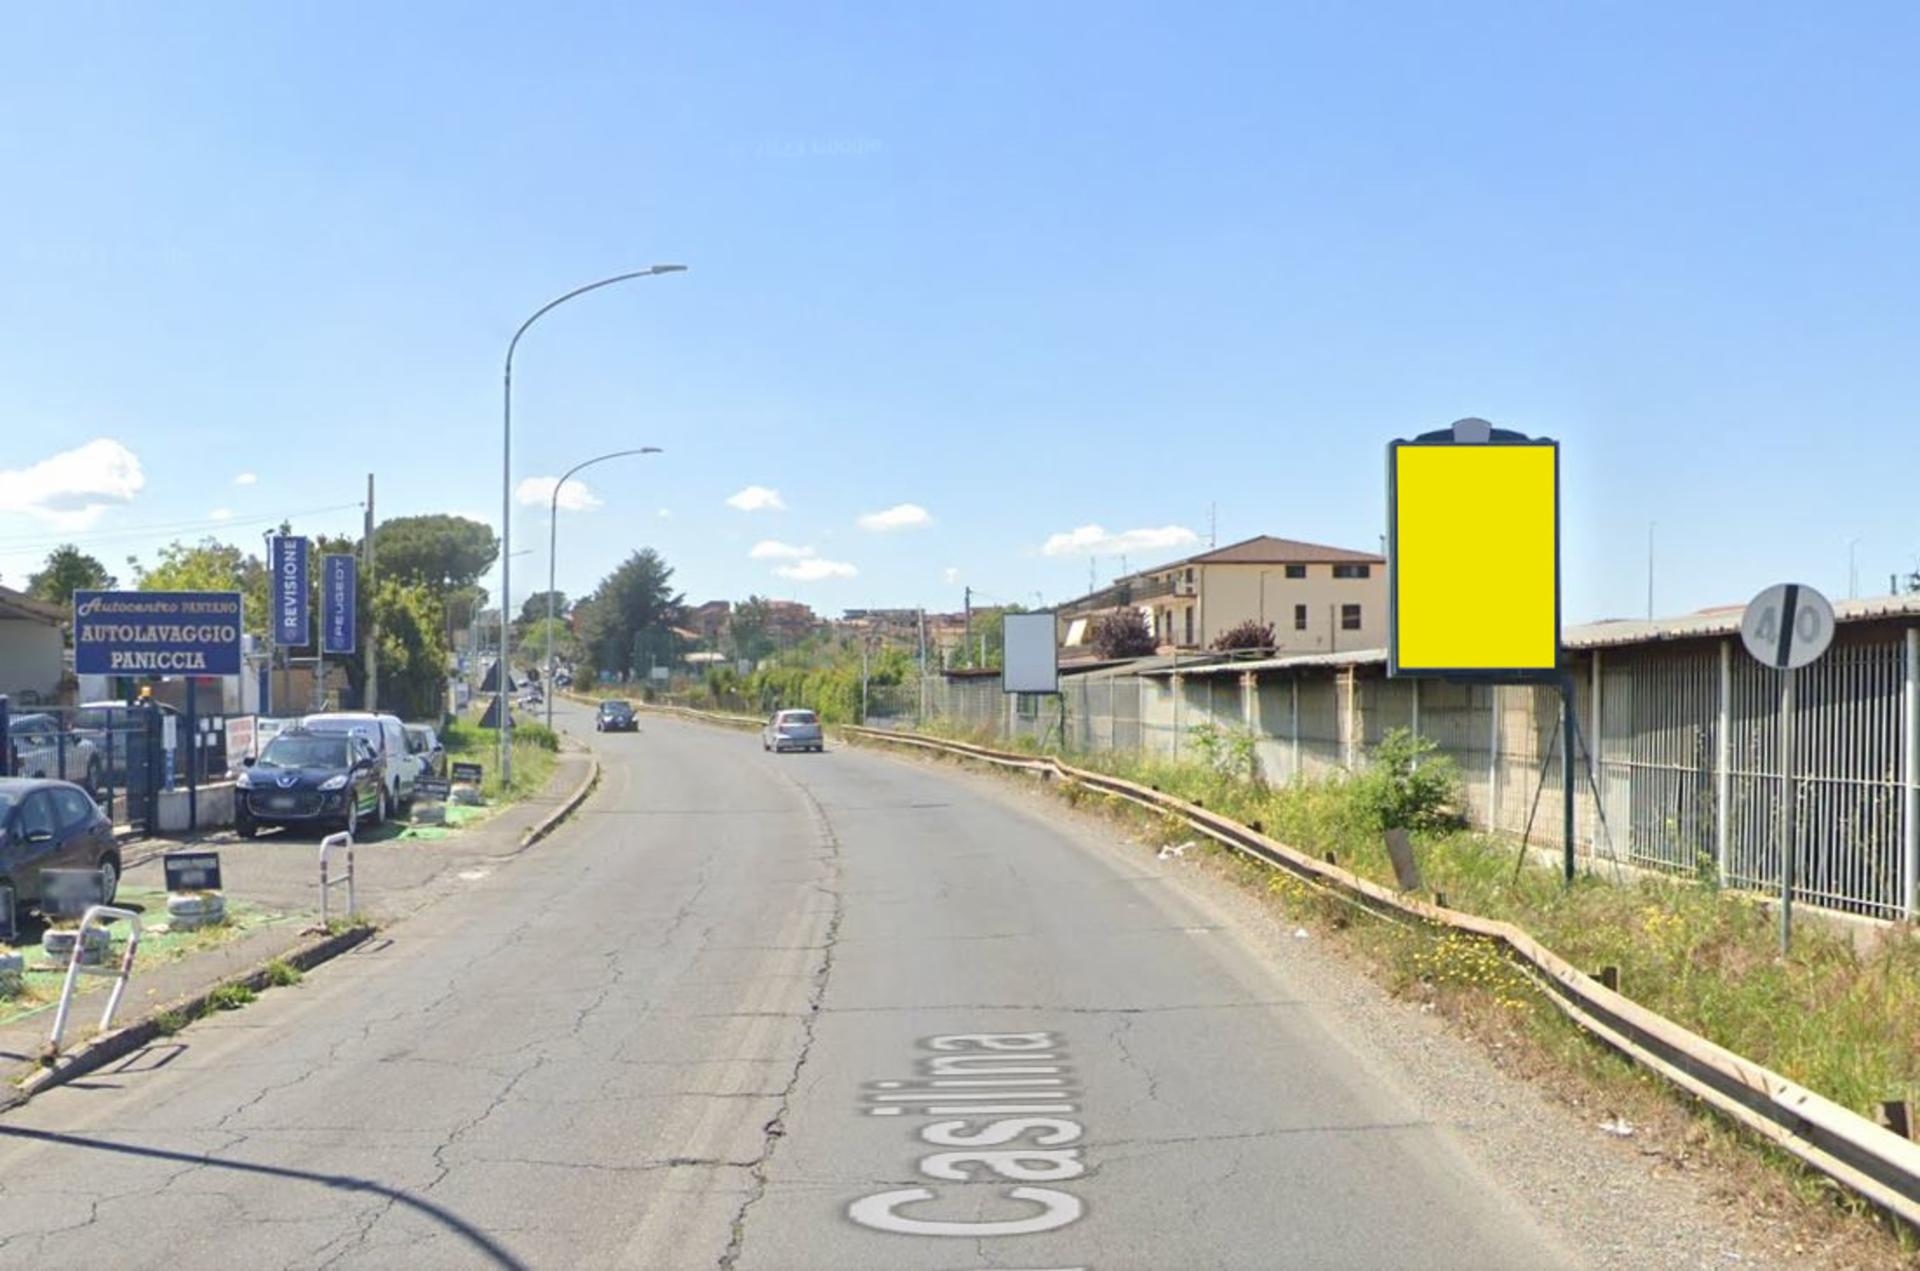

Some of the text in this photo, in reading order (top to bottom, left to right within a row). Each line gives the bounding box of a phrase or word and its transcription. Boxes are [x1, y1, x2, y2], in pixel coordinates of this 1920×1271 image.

[283, 540, 297, 627] REVISIONE
[334, 558, 345, 637] PEUGEOT
[78, 597, 178, 616] Autocentro
[80, 624, 236, 643] AUTOLAVAGGIO
[1753, 604, 1821, 645] 40
[110, 651, 207, 669] PANICCIA
